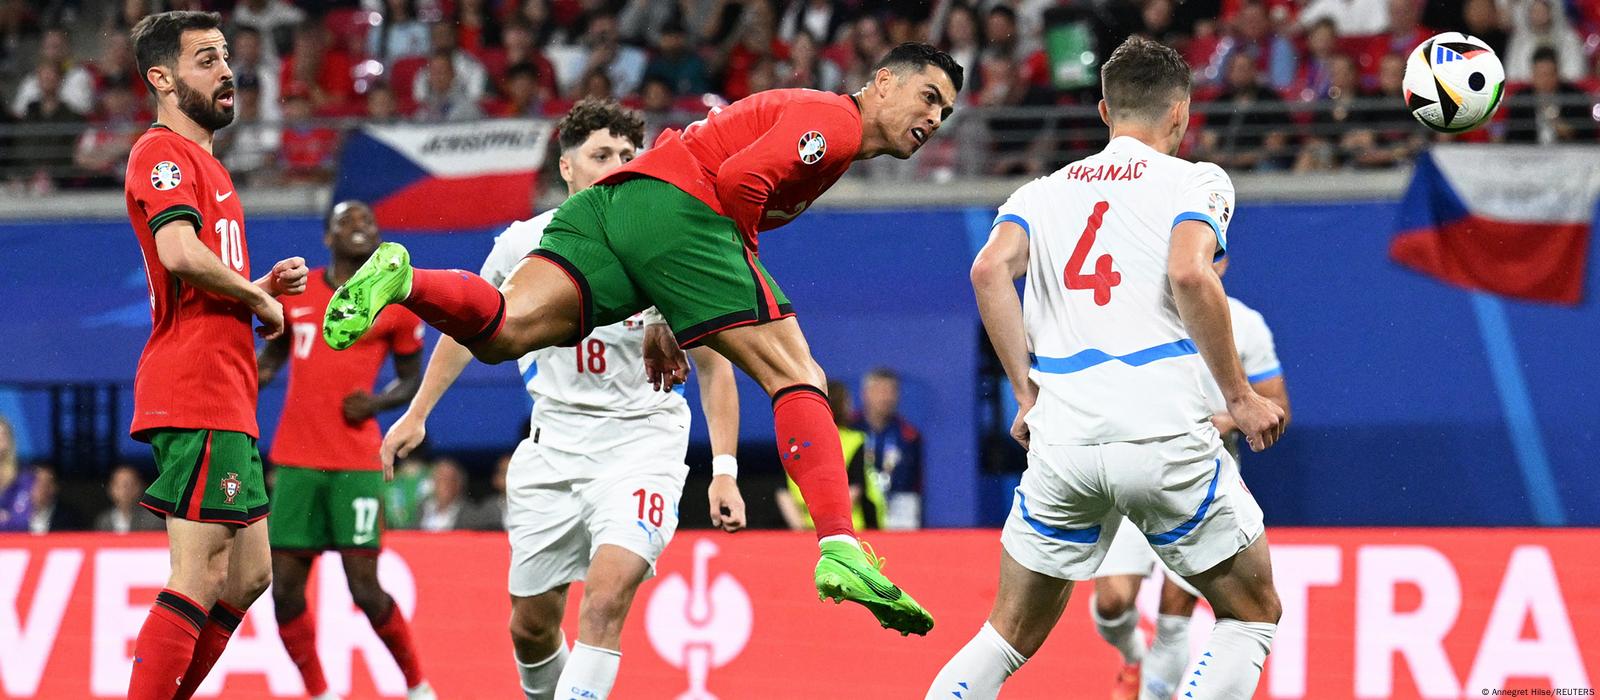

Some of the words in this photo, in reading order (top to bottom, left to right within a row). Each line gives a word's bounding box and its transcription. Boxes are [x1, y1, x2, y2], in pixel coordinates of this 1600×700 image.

[1067, 158, 1148, 183] HRANÁČ
[215, 218, 244, 272] 10
[1063, 200, 1121, 306] 4
[575, 338, 606, 374] 18
[351, 497, 379, 533] 17
[632, 488, 665, 528] 18
